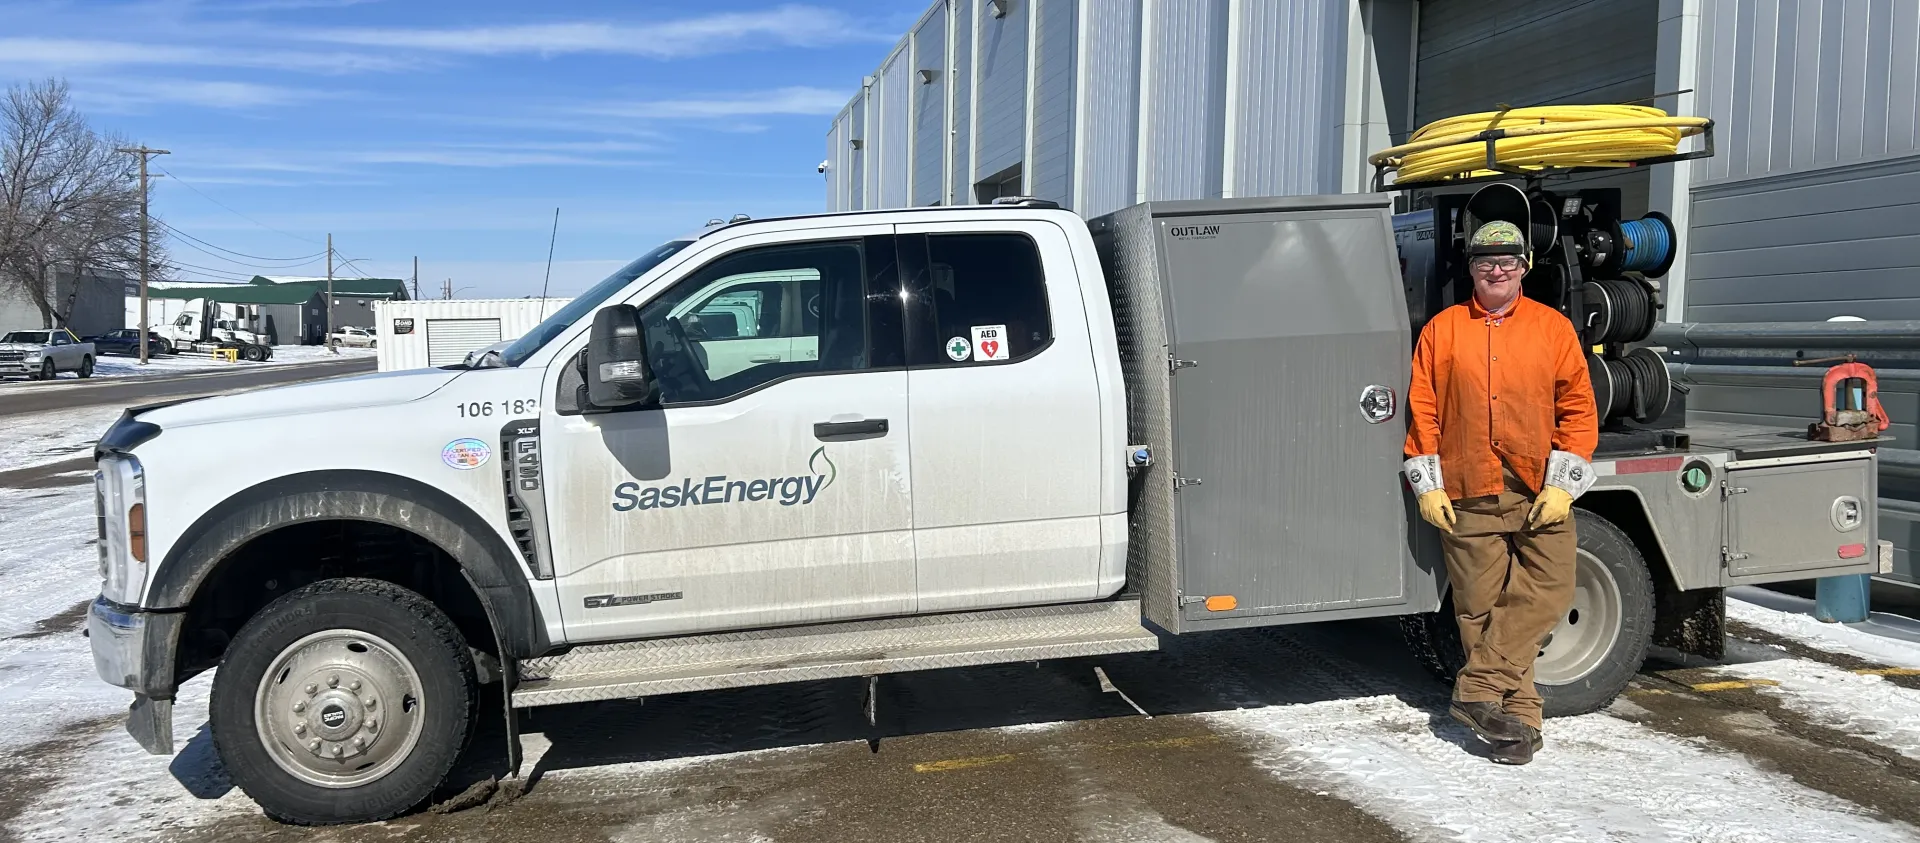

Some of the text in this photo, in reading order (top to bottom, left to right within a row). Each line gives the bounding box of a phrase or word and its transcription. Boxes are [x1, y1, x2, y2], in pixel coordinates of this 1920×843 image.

[1171, 225, 1220, 237] OUTLAW
[980, 330, 998, 339] AED
[456, 398, 536, 418] 106 183
[517, 427, 538, 435] XLT
[612, 474, 826, 512] SaskEnergy
[621, 595, 649, 603] POWER
[650, 592, 682, 601] STROKE
